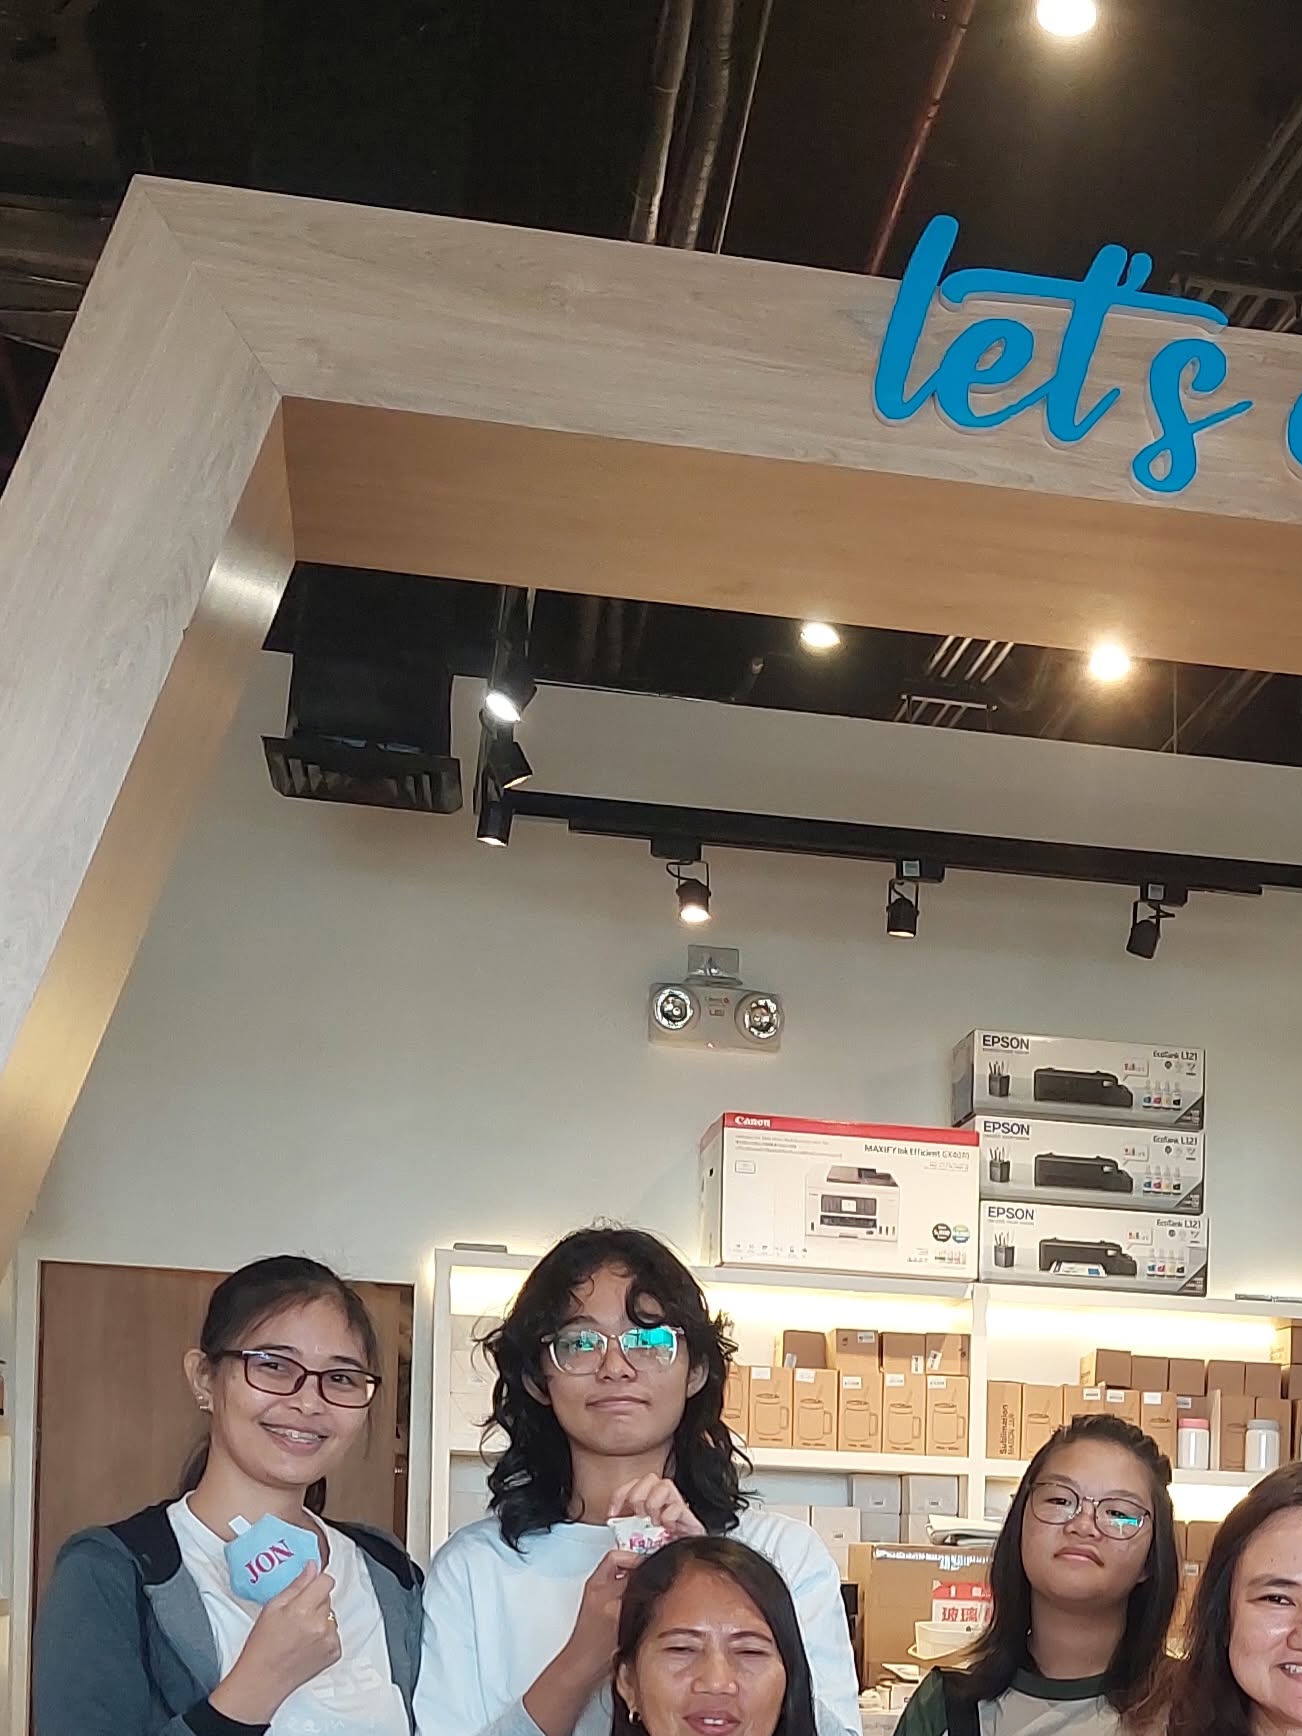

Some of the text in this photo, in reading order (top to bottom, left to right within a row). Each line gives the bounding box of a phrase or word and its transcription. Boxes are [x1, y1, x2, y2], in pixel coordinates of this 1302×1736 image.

[874, 214, 1252, 495] let's
[982, 1034, 1029, 1050] EPSON
[735, 1116, 771, 1128] Canon
[983, 1120, 1030, 1136] EPSON
[988, 1206, 1034, 1221] EPSON
[244, 1538, 294, 1585] JON
